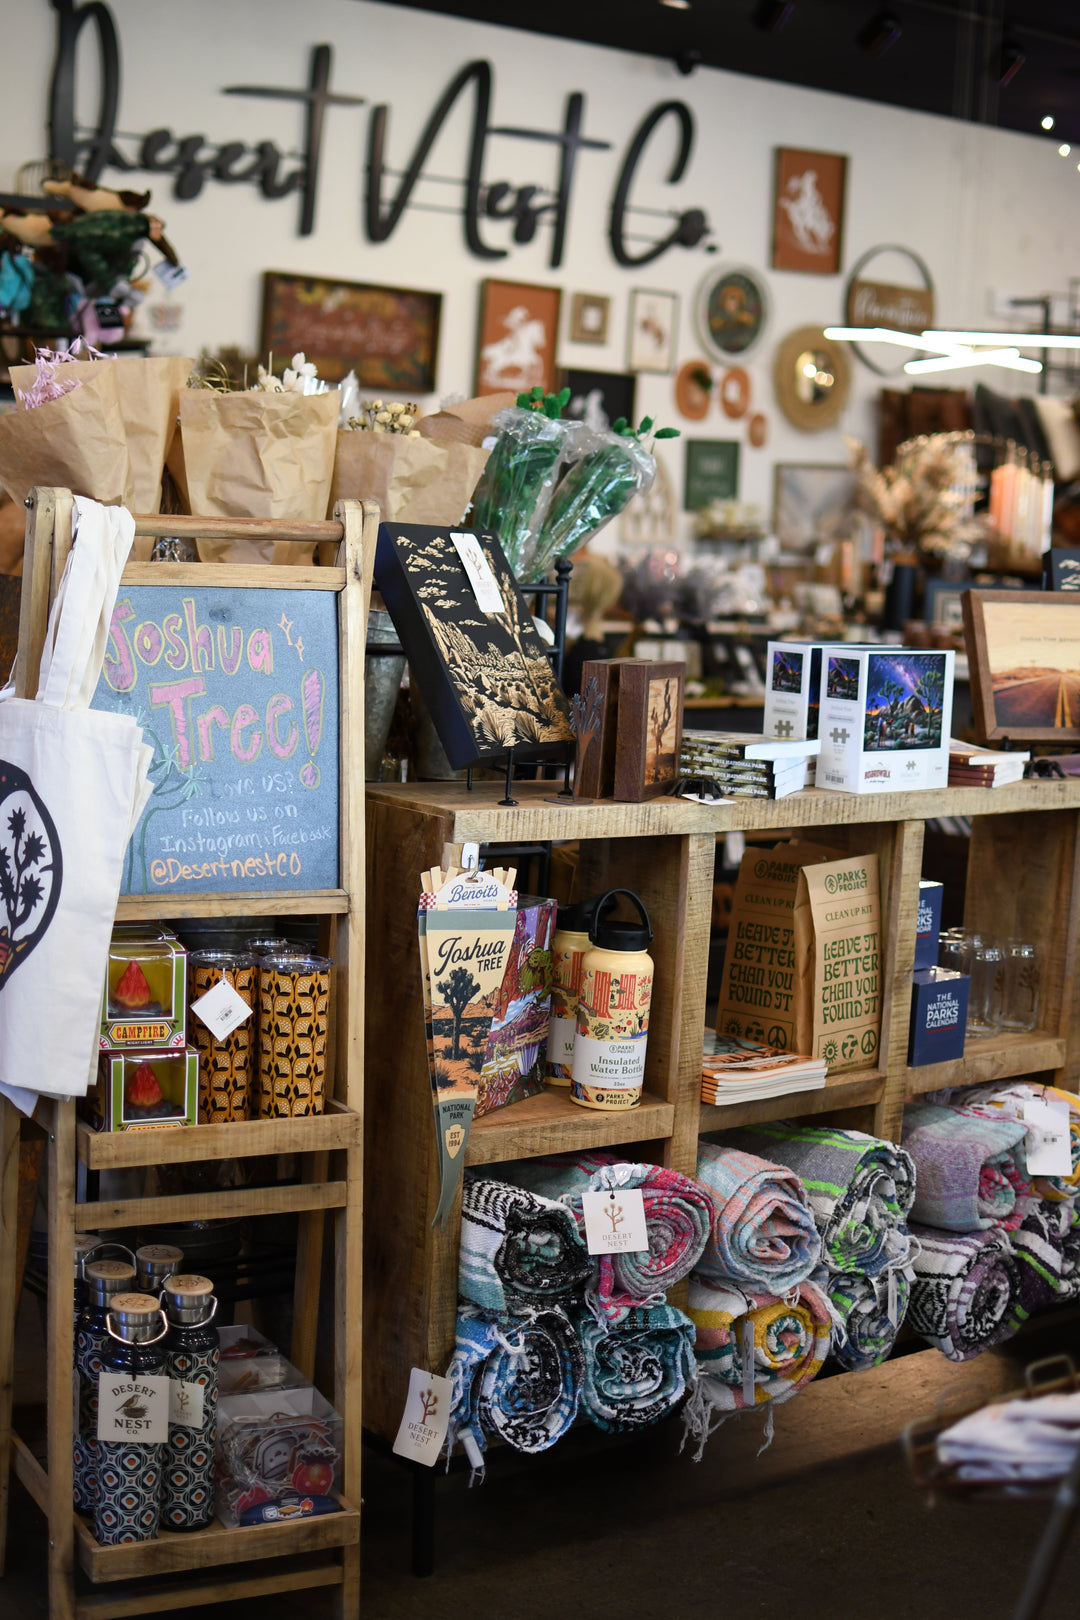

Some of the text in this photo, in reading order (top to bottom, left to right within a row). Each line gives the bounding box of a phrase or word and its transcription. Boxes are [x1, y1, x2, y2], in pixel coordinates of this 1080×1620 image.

[364, 57, 612, 269] Nest
[103, 597, 273, 693] Joshua
[149, 667, 325, 789] Tree!
[182, 804, 298, 828] Follow us on
[159, 832, 263, 857] Instagram
[272, 824, 332, 847] Facebook
[767, 872, 797, 884] PROJEC
[837, 868, 867, 884] PARKS
[448, 884, 499, 904] Benoit's
[838, 880, 868, 892] PROJECT
[745, 894, 795, 910] CLEAN UP KI
[825, 904, 873, 922] CLEAN UP KIT
[737, 921, 781, 945] LEAVE
[823, 932, 878, 961] LEAVE IT
[433, 936, 506, 976] Joshua
[733, 942, 796, 969] BETTER
[477, 956, 503, 973] TREE
[823, 953, 879, 983] BETTER
[729, 962, 794, 991] THAN YOU
[729, 983, 794, 1012] FOUND IT
[821, 975, 878, 1004] THAN YOU
[936, 992, 952, 1002] THE
[822, 995, 879, 1025] FOUND IT
[927, 1000, 959, 1011] NATIONAL
[926, 1006, 959, 1022] PARKS
[925, 1017, 958, 1029] CALENDAR
[116, 1025, 165, 1039] CAMPFIRE
[590, 1063, 619, 1075] Water
[598, 1056, 640, 1066] Insulated
[442, 1103, 472, 1114] NATIONAL
[449, 1111, 464, 1119] PARK
[450, 1131, 461, 1139] EST
[602, 1232, 633, 1241] DESERT
[607, 1240, 628, 1248] NEST
[111, 1383, 156, 1398] DESERT
[114, 1418, 153, 1430] NEST
[407, 1422, 438, 1439] DESERT
[409, 1432, 430, 1445] NEST
